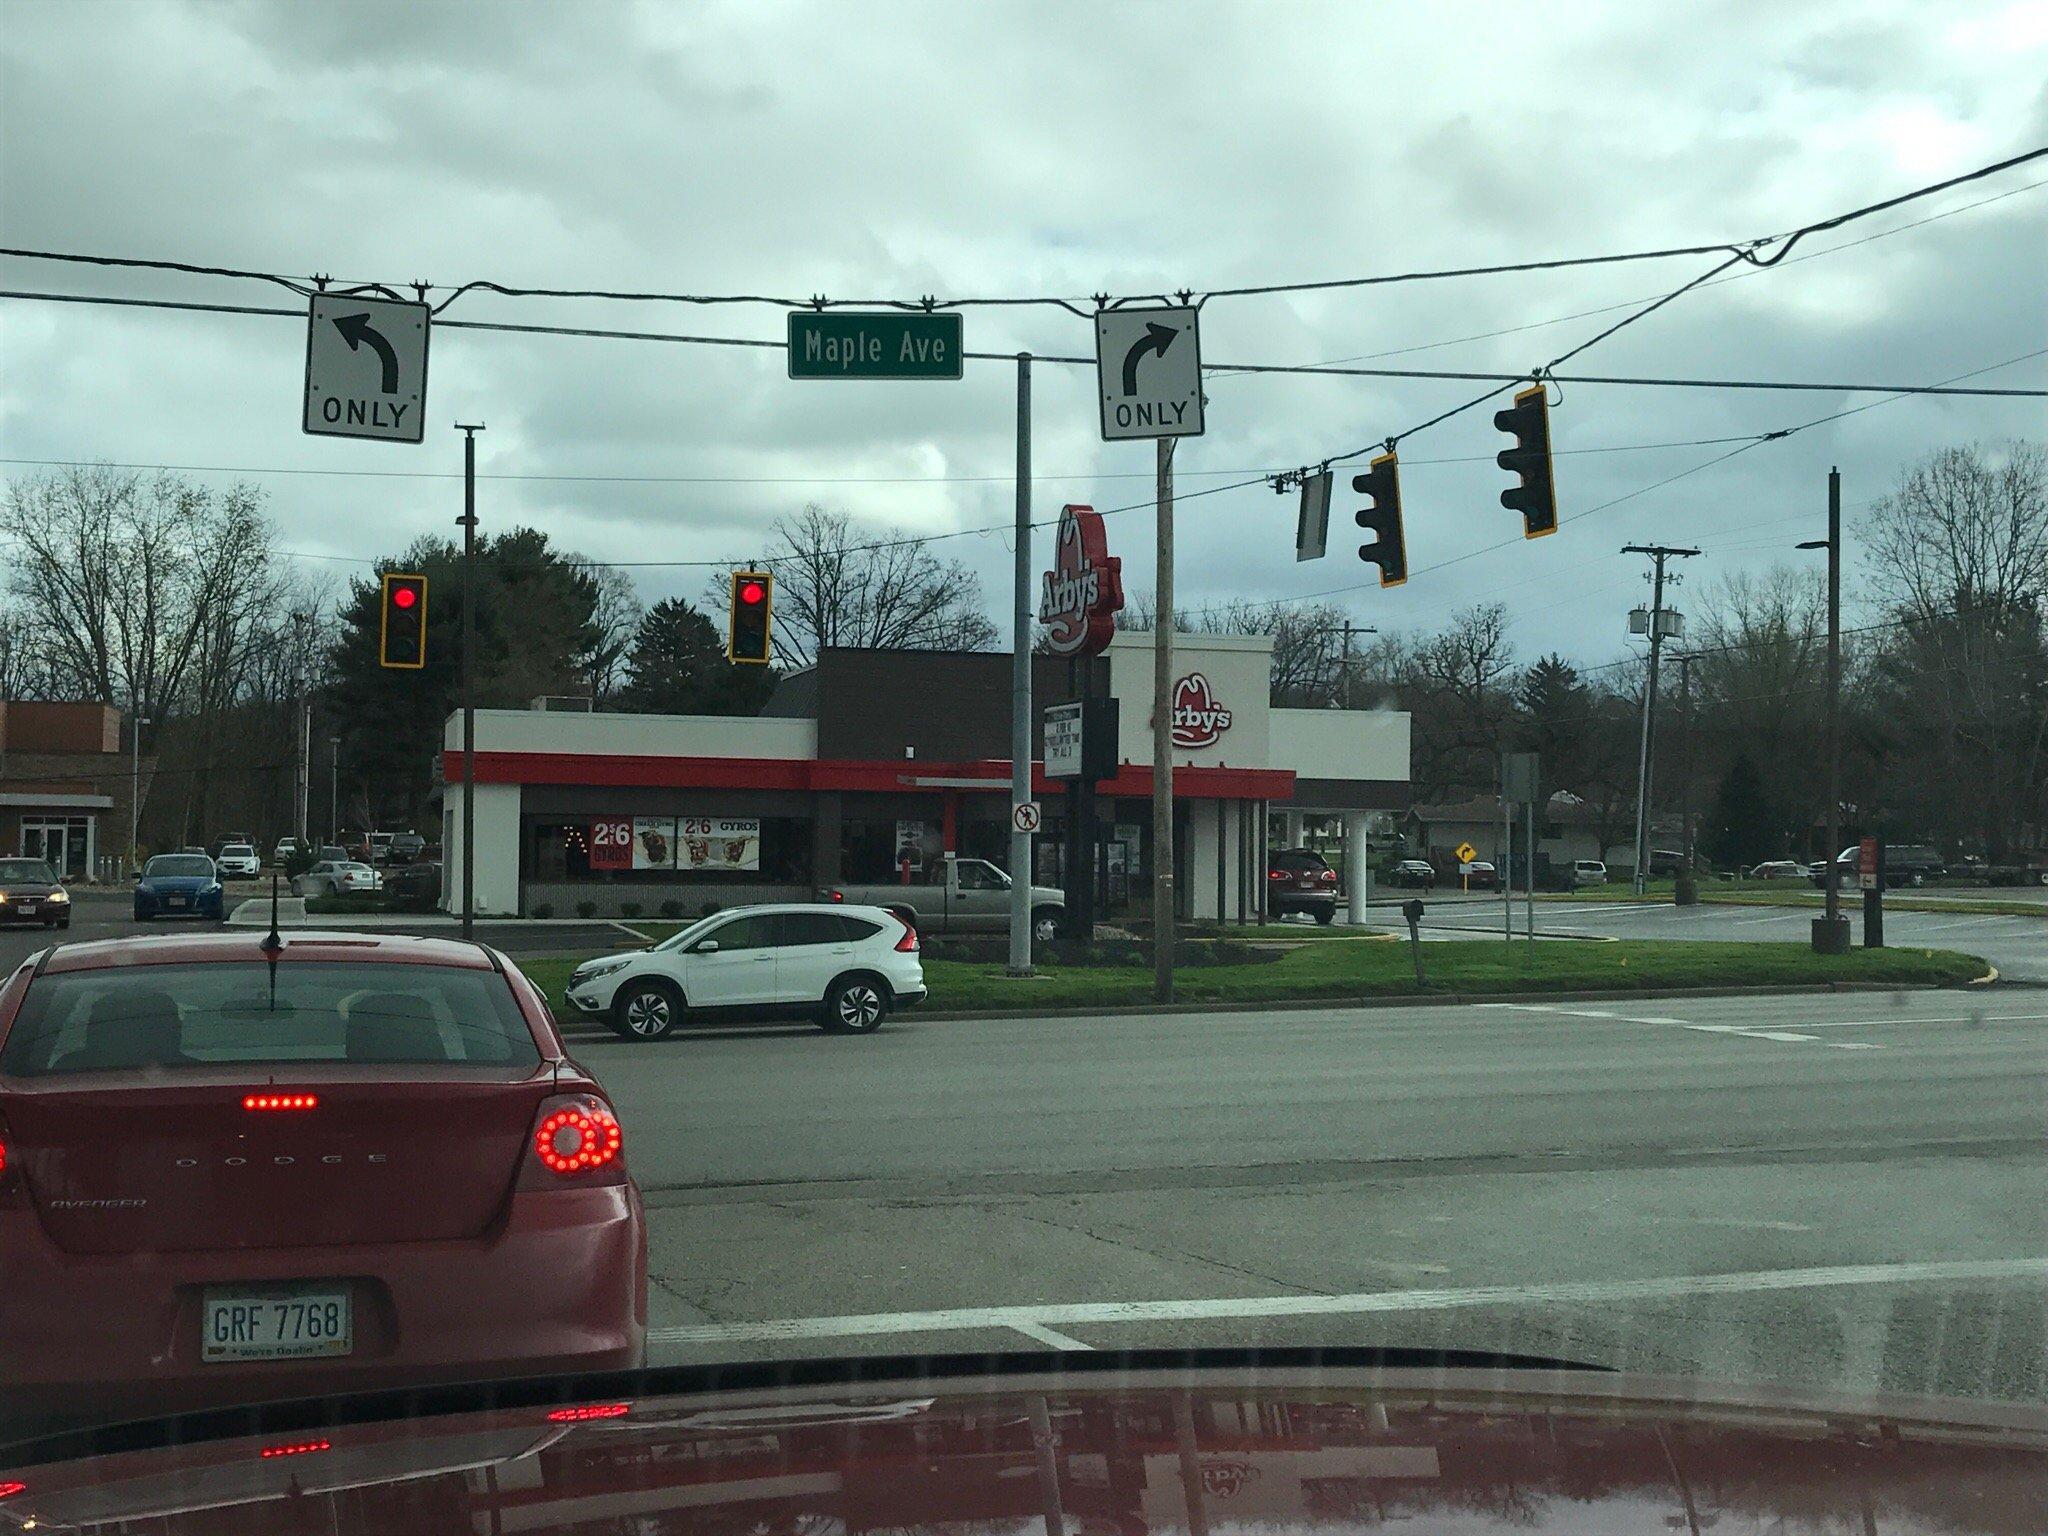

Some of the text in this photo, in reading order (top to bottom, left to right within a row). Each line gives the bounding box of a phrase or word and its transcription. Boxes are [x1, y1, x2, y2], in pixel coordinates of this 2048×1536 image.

[805, 329, 946, 370] Maple Ave
[323, 397, 409, 428] ONLY
[1116, 401, 1187, 428] ONLY
[1040, 558, 1098, 622] Arby's
[1172, 703, 1231, 733] rby's
[720, 821, 758, 832] GYROS
[176, 1154, 387, 1168] DODGE
[51, 1199, 148, 1209] AVENGER
[215, 1302, 339, 1342] GRF 7768
